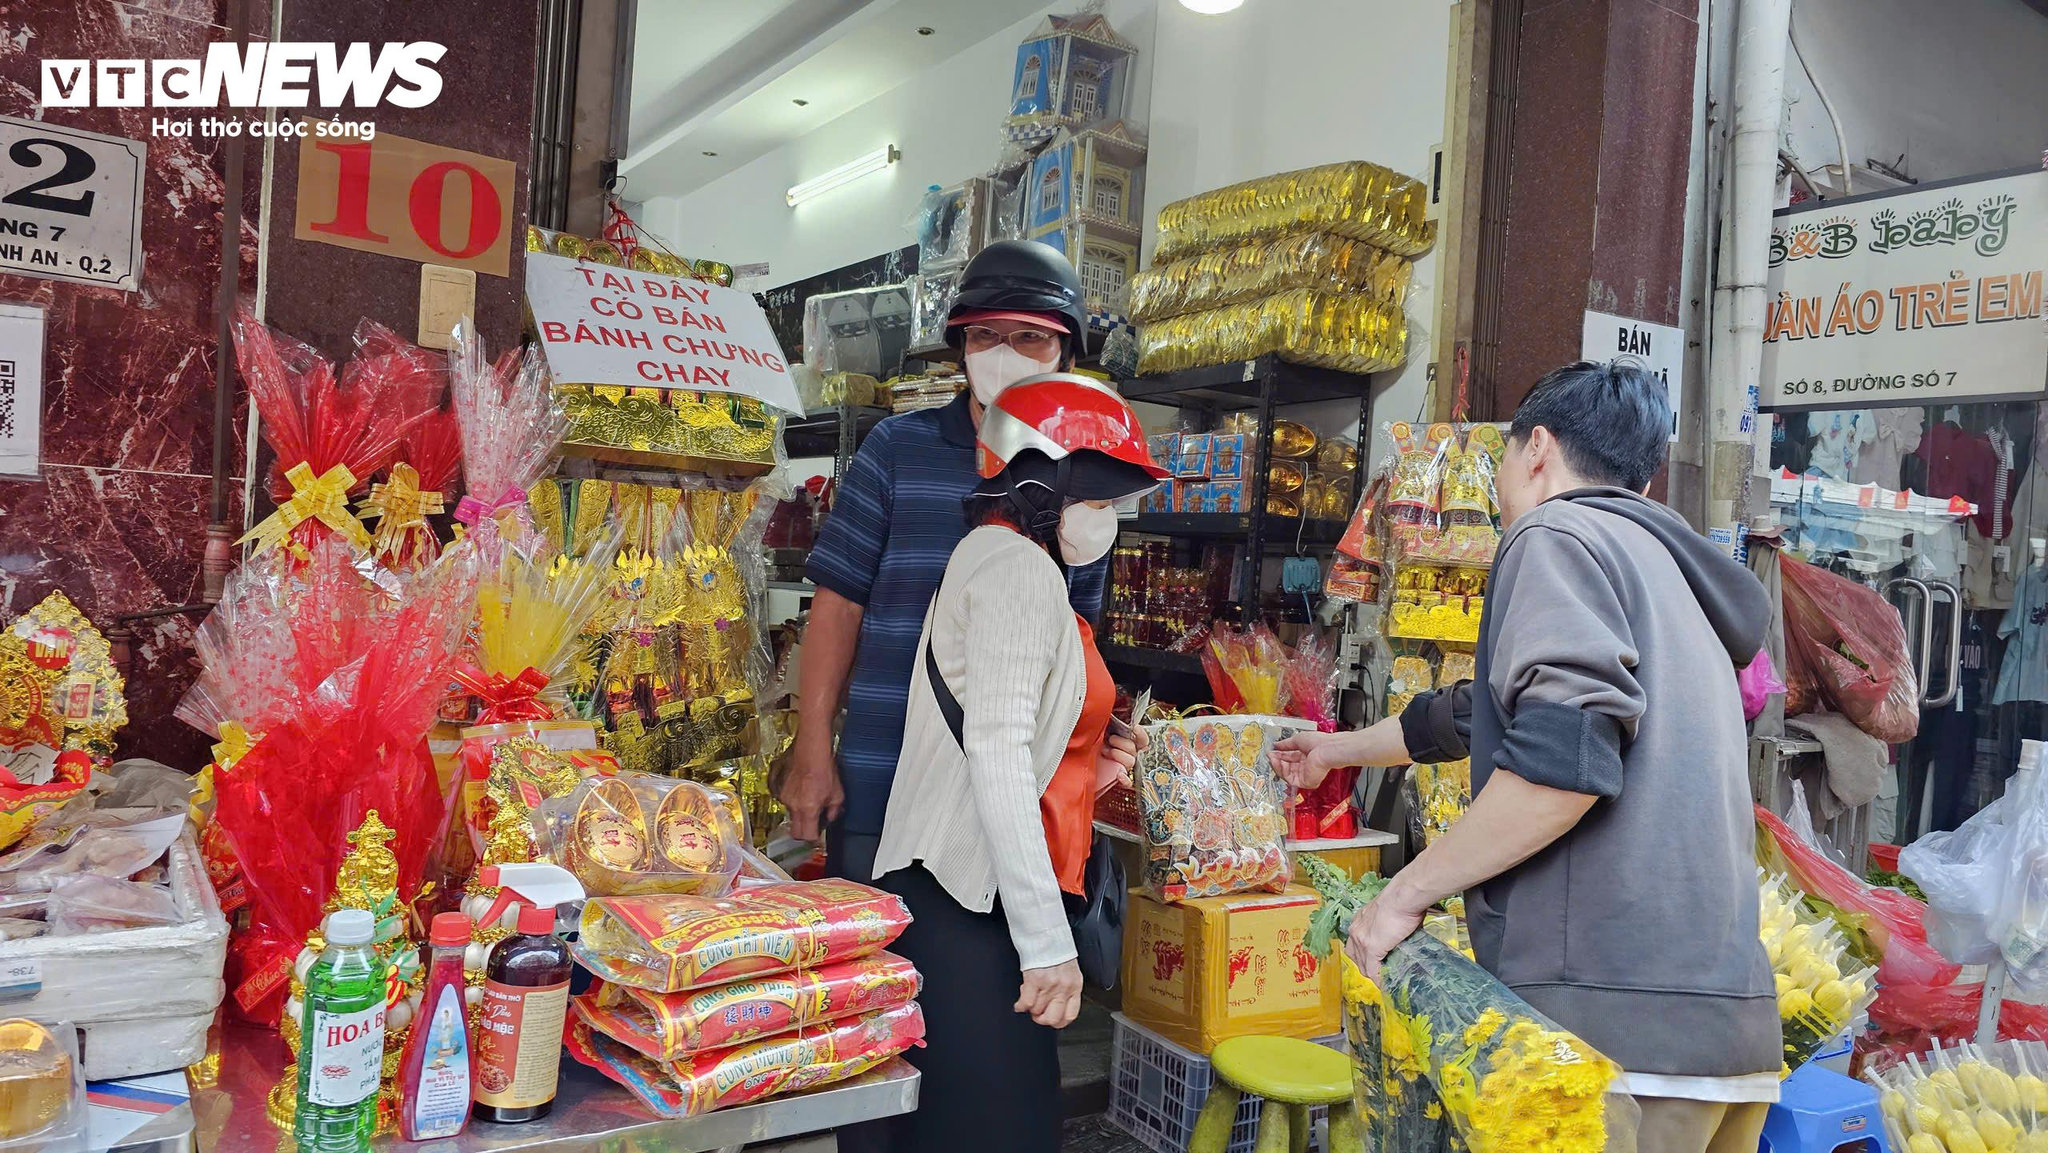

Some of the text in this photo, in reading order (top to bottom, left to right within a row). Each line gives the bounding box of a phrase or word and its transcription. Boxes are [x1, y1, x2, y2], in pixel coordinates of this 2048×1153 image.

[310, 141, 502, 259] 10
[0, 218, 66, 242] NG 7
[1870, 196, 2017, 256] baby
[0, 244, 23, 261] NH
[30, 249, 58, 266] AN
[79, 256, 112, 275] Q.2
[575, 267, 710, 305] TẠI ĐÂY
[590, 296, 727, 333] CÓ BÁN
[1826, 282, 1885, 336] ÁO
[1890, 270, 1970, 331] TRẺ
[1976, 271, 2043, 323] EM
[542, 319, 785, 373] BÁNH CHƯNG
[1618, 325, 1651, 356] BÁN
[637, 360, 730, 387] CHAY
[1813, 380, 1827, 395] 8,
[1833, 374, 1905, 392] ĐƯỜNG
[1946, 371, 1957, 386] 7
[726, 983, 757, 997] GIAO
[326, 1019, 371, 1048] HOA
